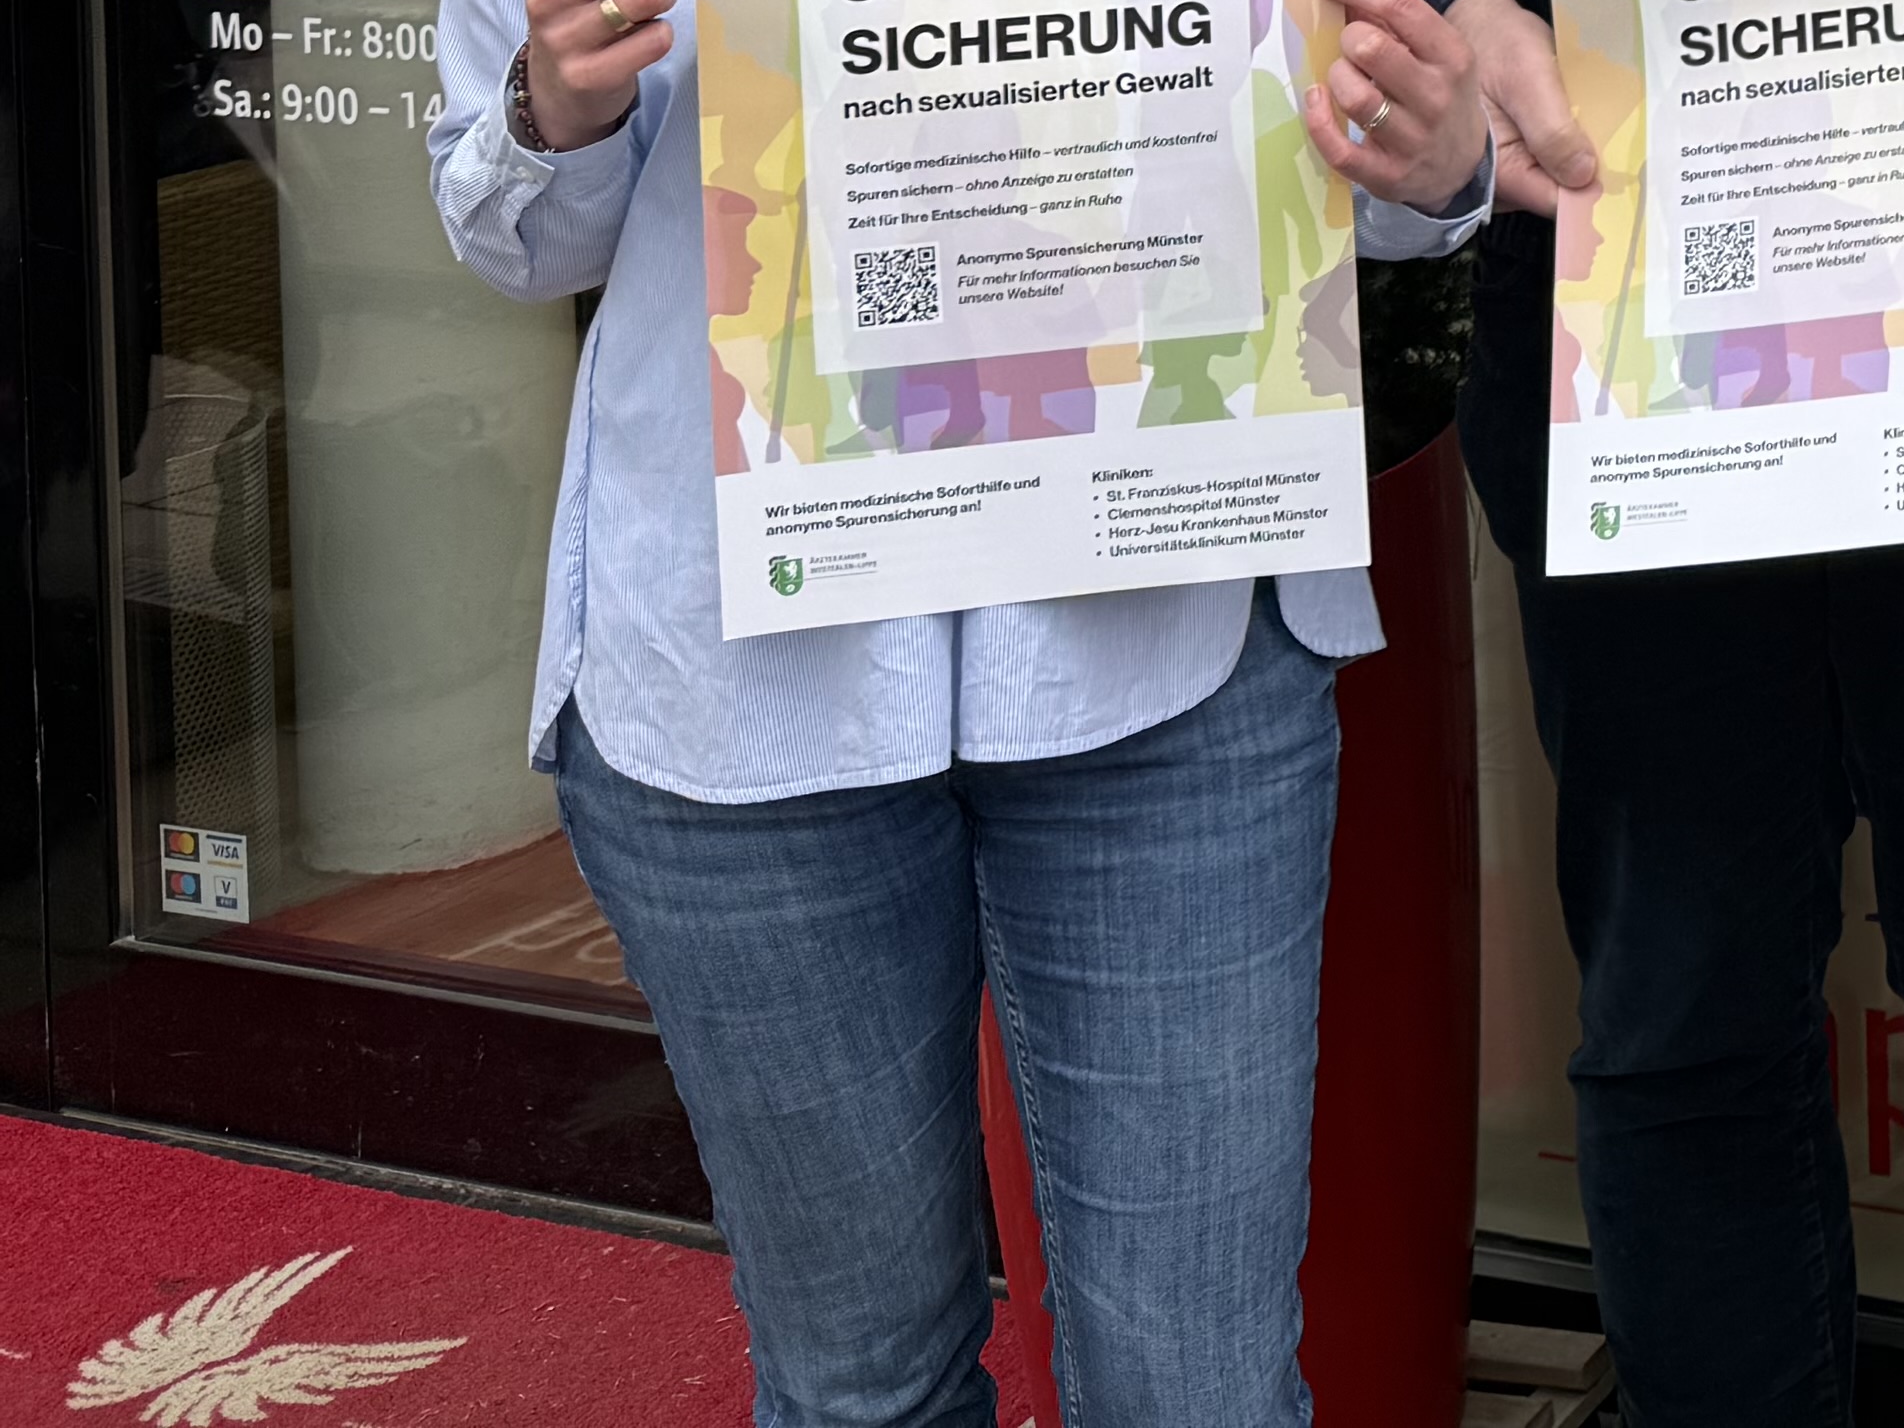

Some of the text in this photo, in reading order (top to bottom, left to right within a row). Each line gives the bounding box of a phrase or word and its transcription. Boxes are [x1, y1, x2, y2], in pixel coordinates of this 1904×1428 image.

[211, 11, 263, 52] Mo
[303, 17, 353, 57] Fr.:
[363, 21, 438, 62] 8:00
[842, 1, 1212, 75] SICHERUNG
[213, 79, 272, 120] Sa.:
[282, 83, 359, 125] 9:00
[843, 65, 1213, 119] nach sexualisierter Gewalt
[1681, 80, 1741, 107] nach
[211, 843, 240, 860] VISA
